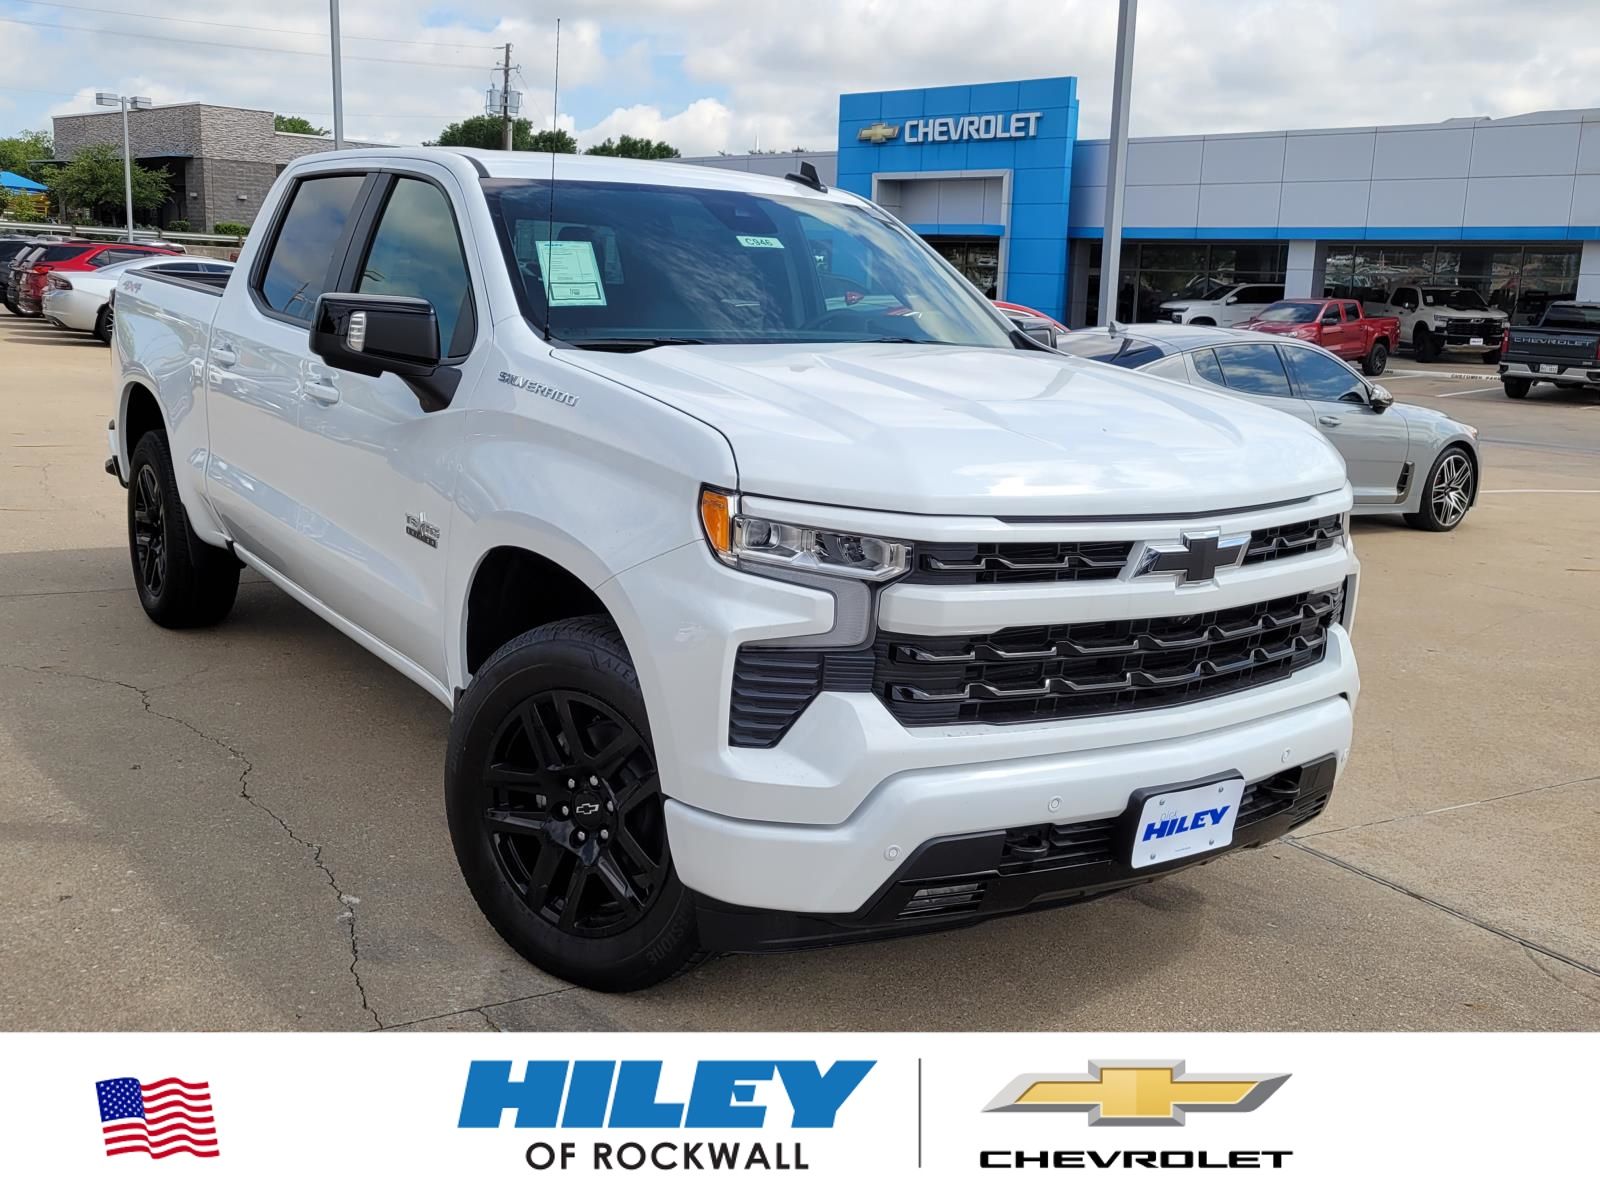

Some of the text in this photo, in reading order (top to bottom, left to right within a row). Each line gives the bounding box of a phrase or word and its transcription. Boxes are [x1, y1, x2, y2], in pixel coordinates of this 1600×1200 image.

[904, 112, 1042, 143] CHEVROLET
[1514, 337, 1593, 347] CHEVROLET
[498, 371, 580, 407] SILVERADO
[1142, 805, 1231, 842] HILEY
